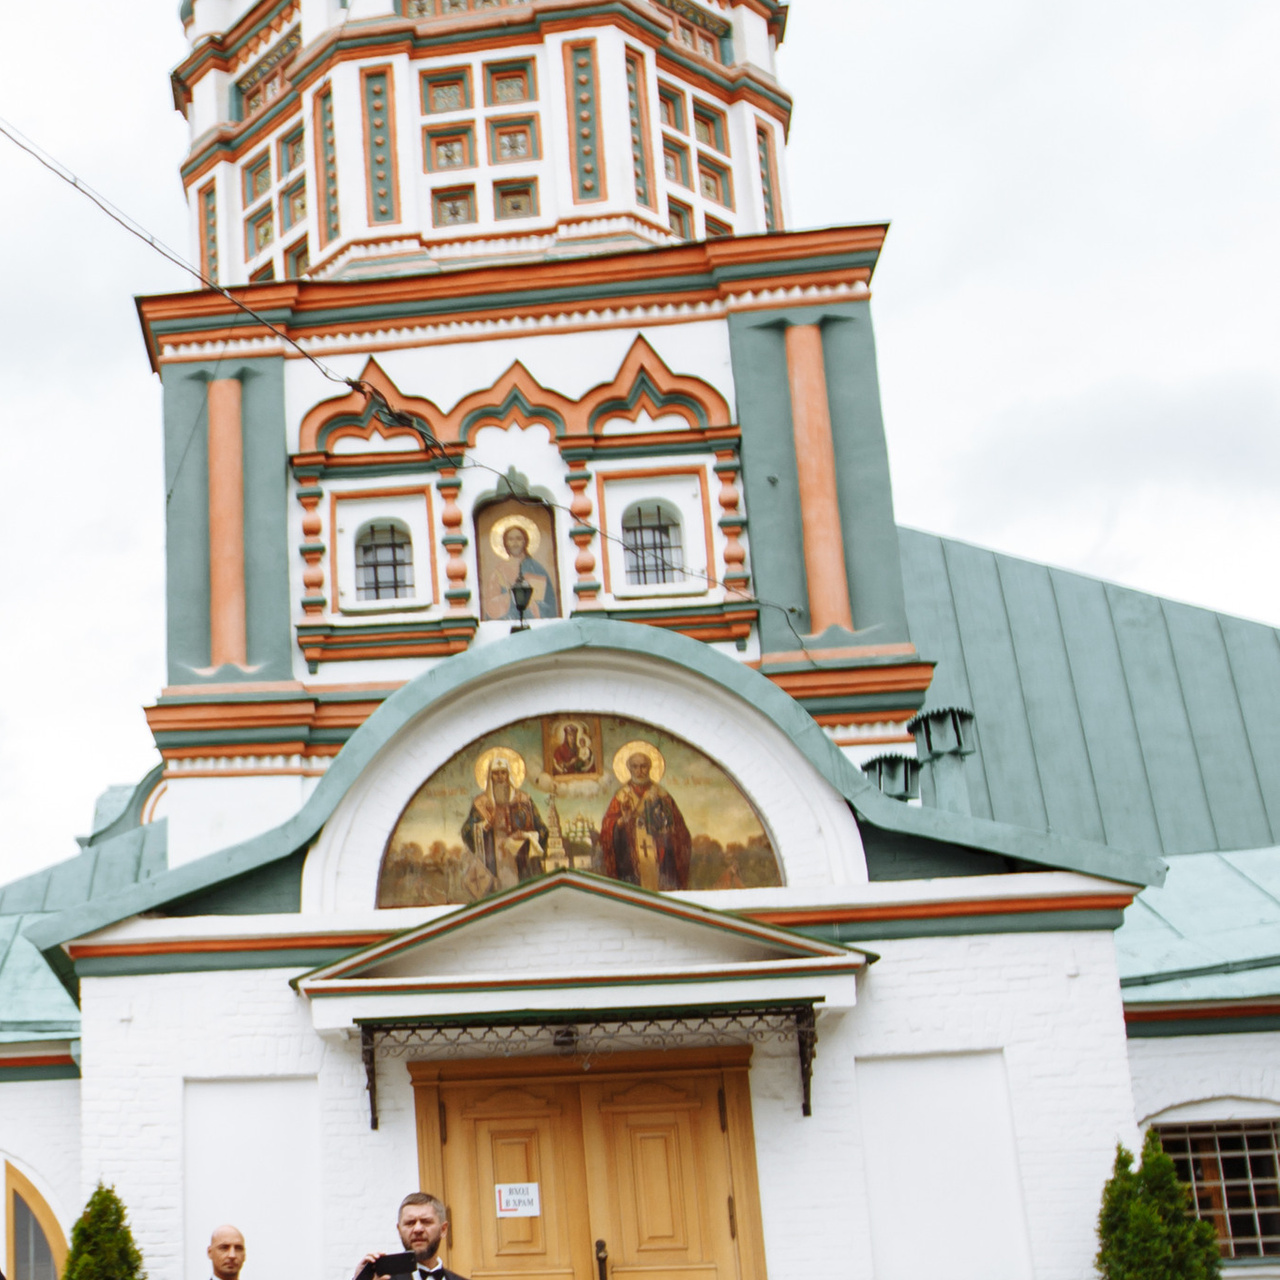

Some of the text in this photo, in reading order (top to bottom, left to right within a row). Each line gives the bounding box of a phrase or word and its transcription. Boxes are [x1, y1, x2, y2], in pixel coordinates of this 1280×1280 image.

[508, 1187, 530, 1196] ВХОД
[505, 1198, 534, 1207] В ХРАМ
